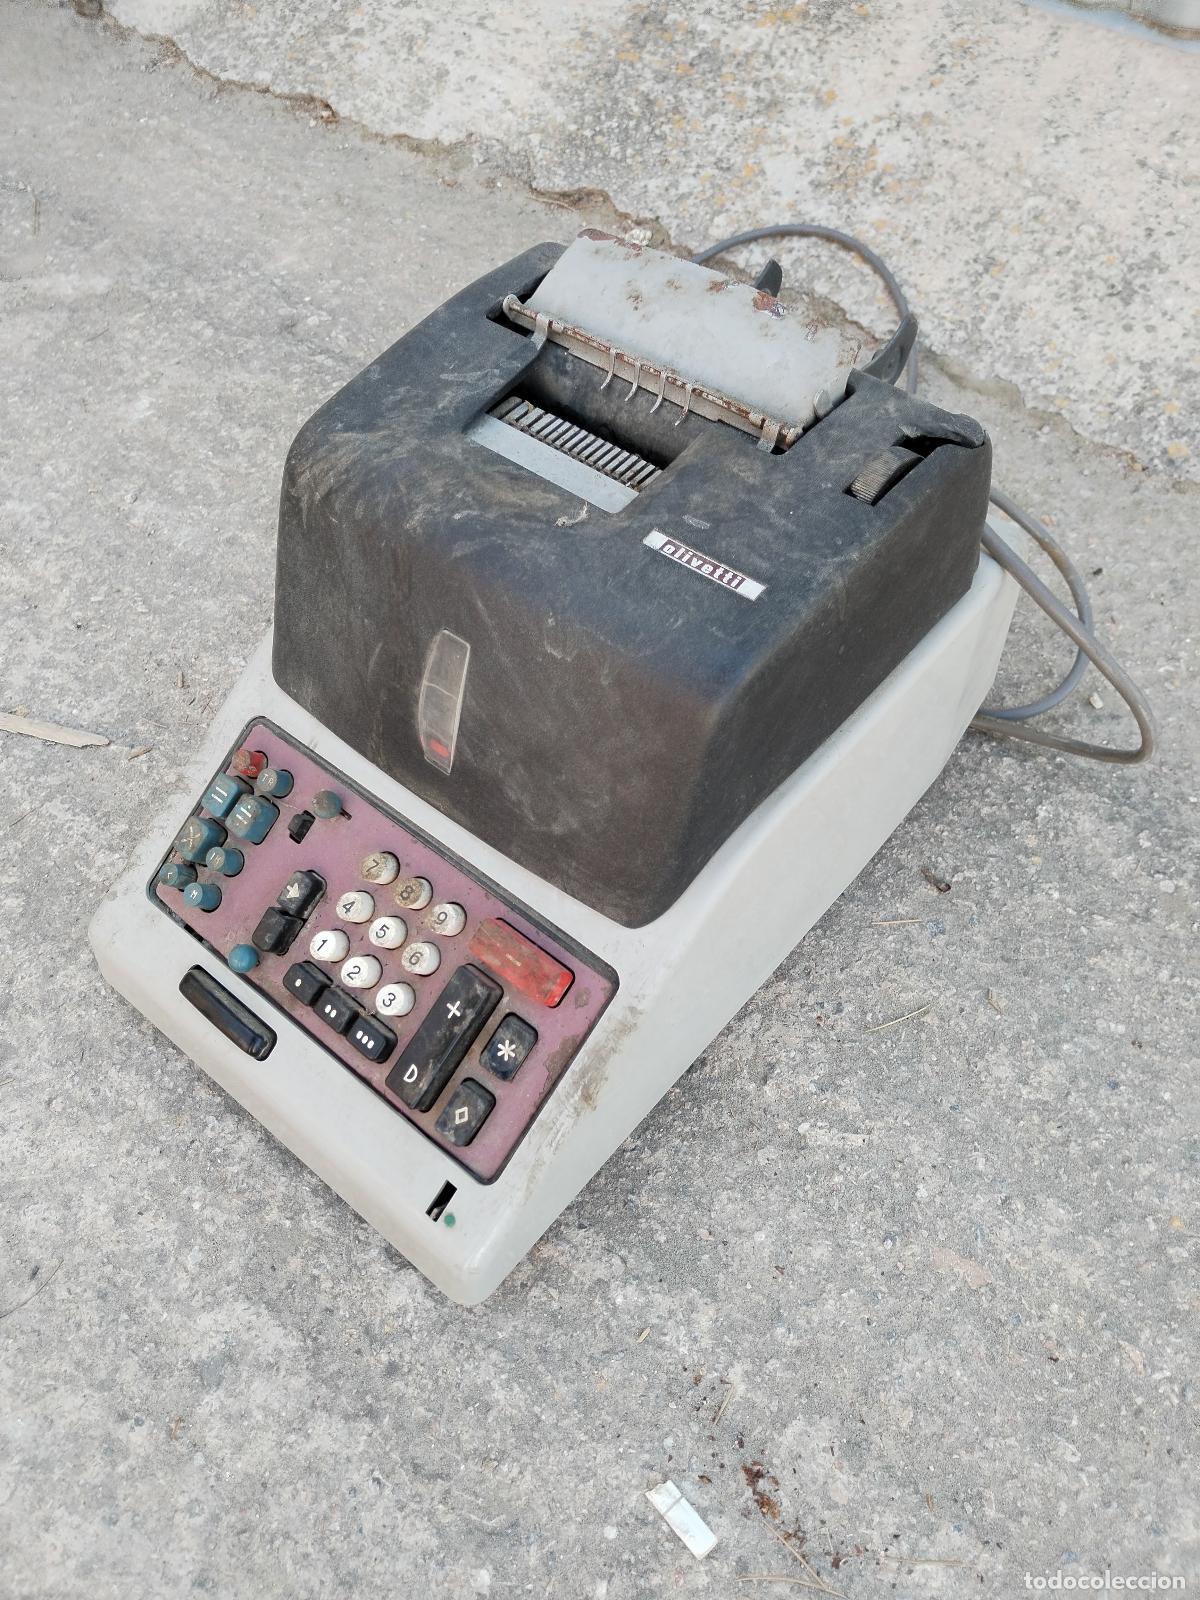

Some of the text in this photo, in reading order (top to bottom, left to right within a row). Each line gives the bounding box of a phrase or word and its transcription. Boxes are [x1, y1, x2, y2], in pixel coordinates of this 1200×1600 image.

[662, 543, 742, 588] olivetti
[365, 859, 380, 872] 7
[400, 885, 414, 900] 8
[342, 900, 356, 914] 4
[433, 911, 448, 926] 9
[375, 924, 390, 939] 5
[316, 939, 328, 952] 1
[408, 951, 423, 966] 6
[346, 965, 361, 981] 2
[382, 992, 396, 1008] 3
[403, 1063, 418, 1083] D
